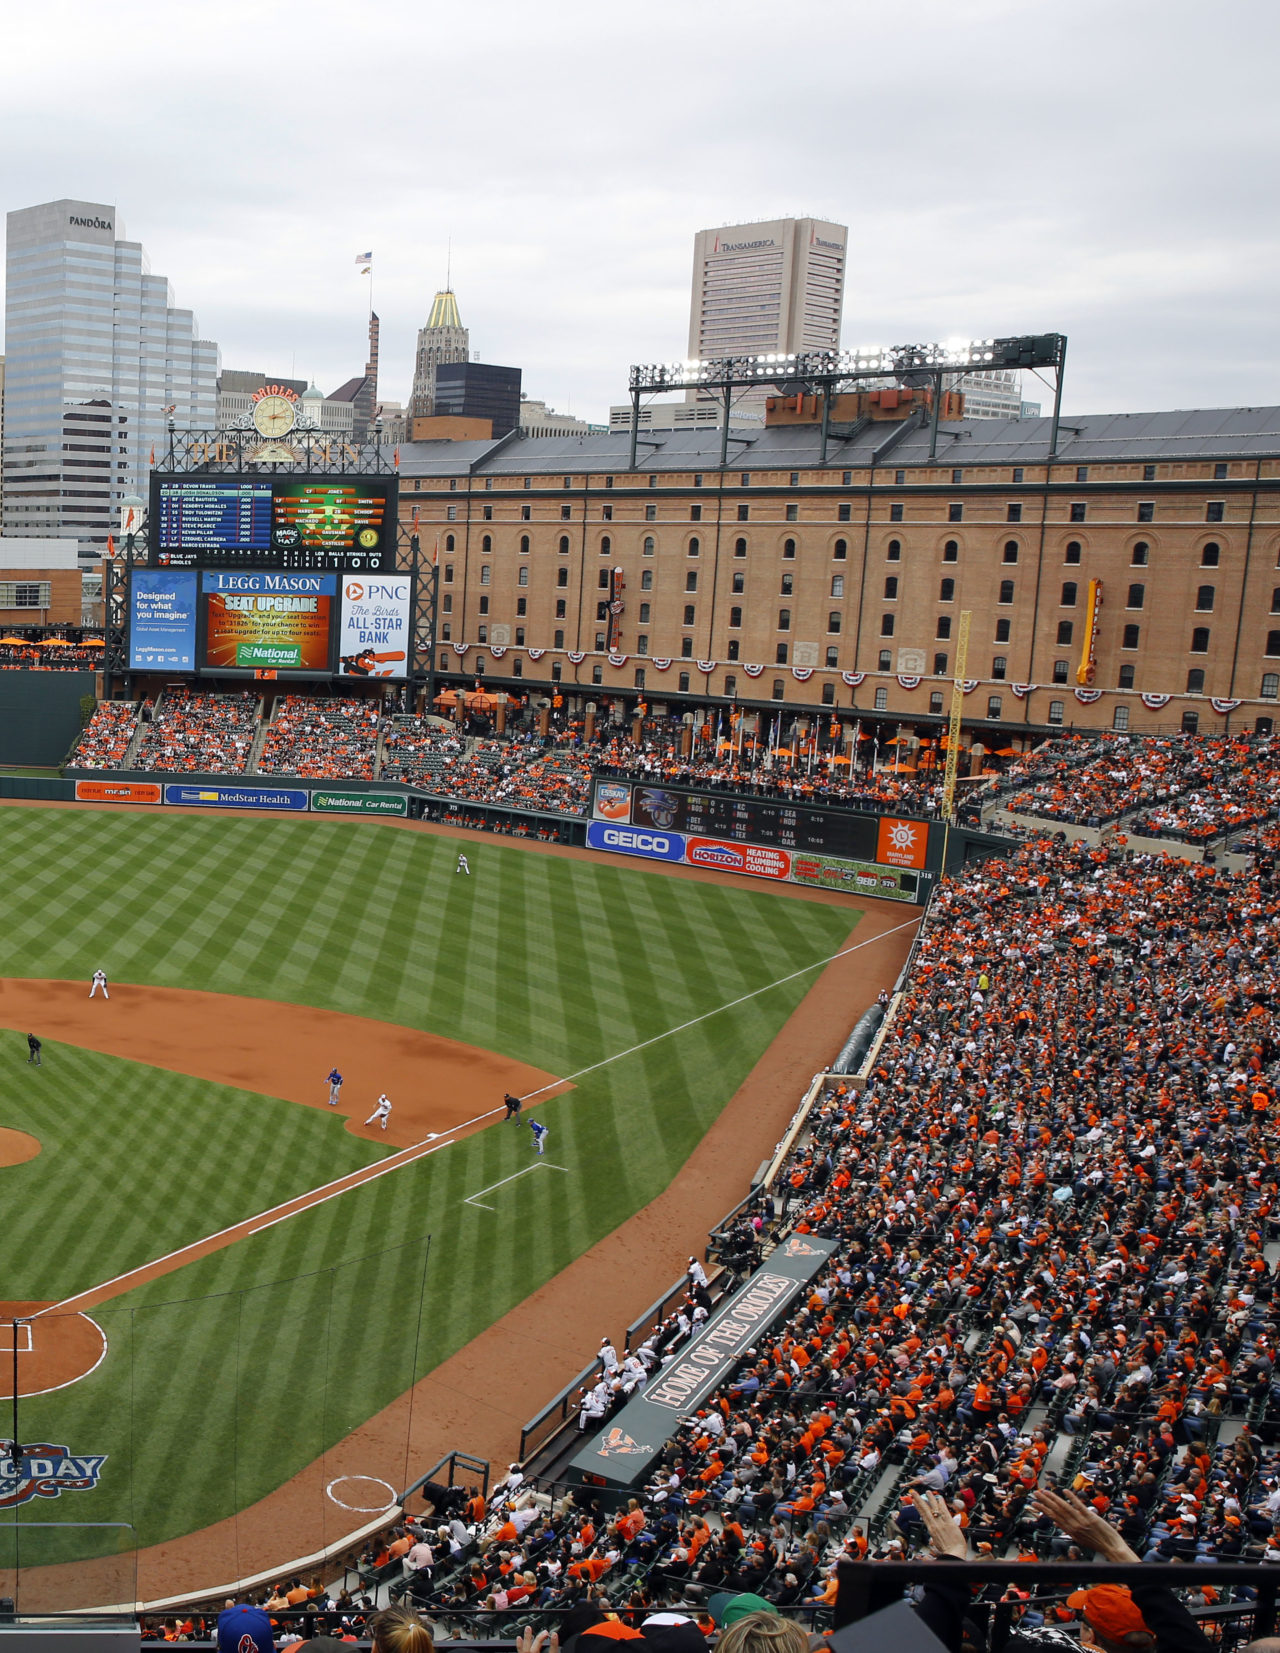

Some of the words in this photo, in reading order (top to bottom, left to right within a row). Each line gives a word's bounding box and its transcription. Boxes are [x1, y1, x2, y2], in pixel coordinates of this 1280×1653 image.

[69, 216, 112, 230] PANDORA
[721, 240, 775, 252] TRANSAMERICA
[251, 385, 300, 403] ORIOLES
[188, 443, 237, 463] THE
[312, 443, 361, 463] SUN
[276, 529, 298, 537] MAGIC
[334, 558, 338, 567] 1
[352, 558, 360, 568] 0
[371, 558, 379, 568] 0
[218, 574, 260, 590] LEGG
[264, 575, 321, 591] MASON
[137, 591, 175, 601] Designed
[368, 585, 407, 600] PNC
[136, 601, 149, 609] for
[150, 602, 172, 610] what
[224, 595, 255, 611] SEAT
[257, 596, 318, 613] UPGRADE
[351, 605, 370, 616] The
[372, 605, 400, 617] Birds
[347, 617, 402, 630] ALL-STAR
[359, 631, 389, 644] BANK
[252, 647, 298, 659] National
[220, 793, 257, 803] MedStar
[259, 795, 290, 804] Health
[601, 788, 625, 798] ESSKAY
[327, 798, 363, 807] National
[380, 801, 403, 810] Rental
[784, 810, 797, 818] SEA
[603, 829, 670, 853] GEICO
[735, 831, 746, 839] TEX
[694, 850, 743, 866] HORIZON
[746, 848, 780, 860] HEATING
[886, 851, 915, 860] MARYLAND
[745, 856, 785, 869] PLUMBING
[888, 857, 911, 866] LOTTERY
[745, 864, 779, 876] COOLING
[920, 871, 933, 879] 318
[856, 876, 877, 887] 980
[650, 1364, 711, 1406] HOME
[689, 1344, 725, 1366] OF
[707, 1318, 751, 1348] THE
[730, 1275, 791, 1322] ORIOLES
[30, 1459, 101, 1478] DAY
